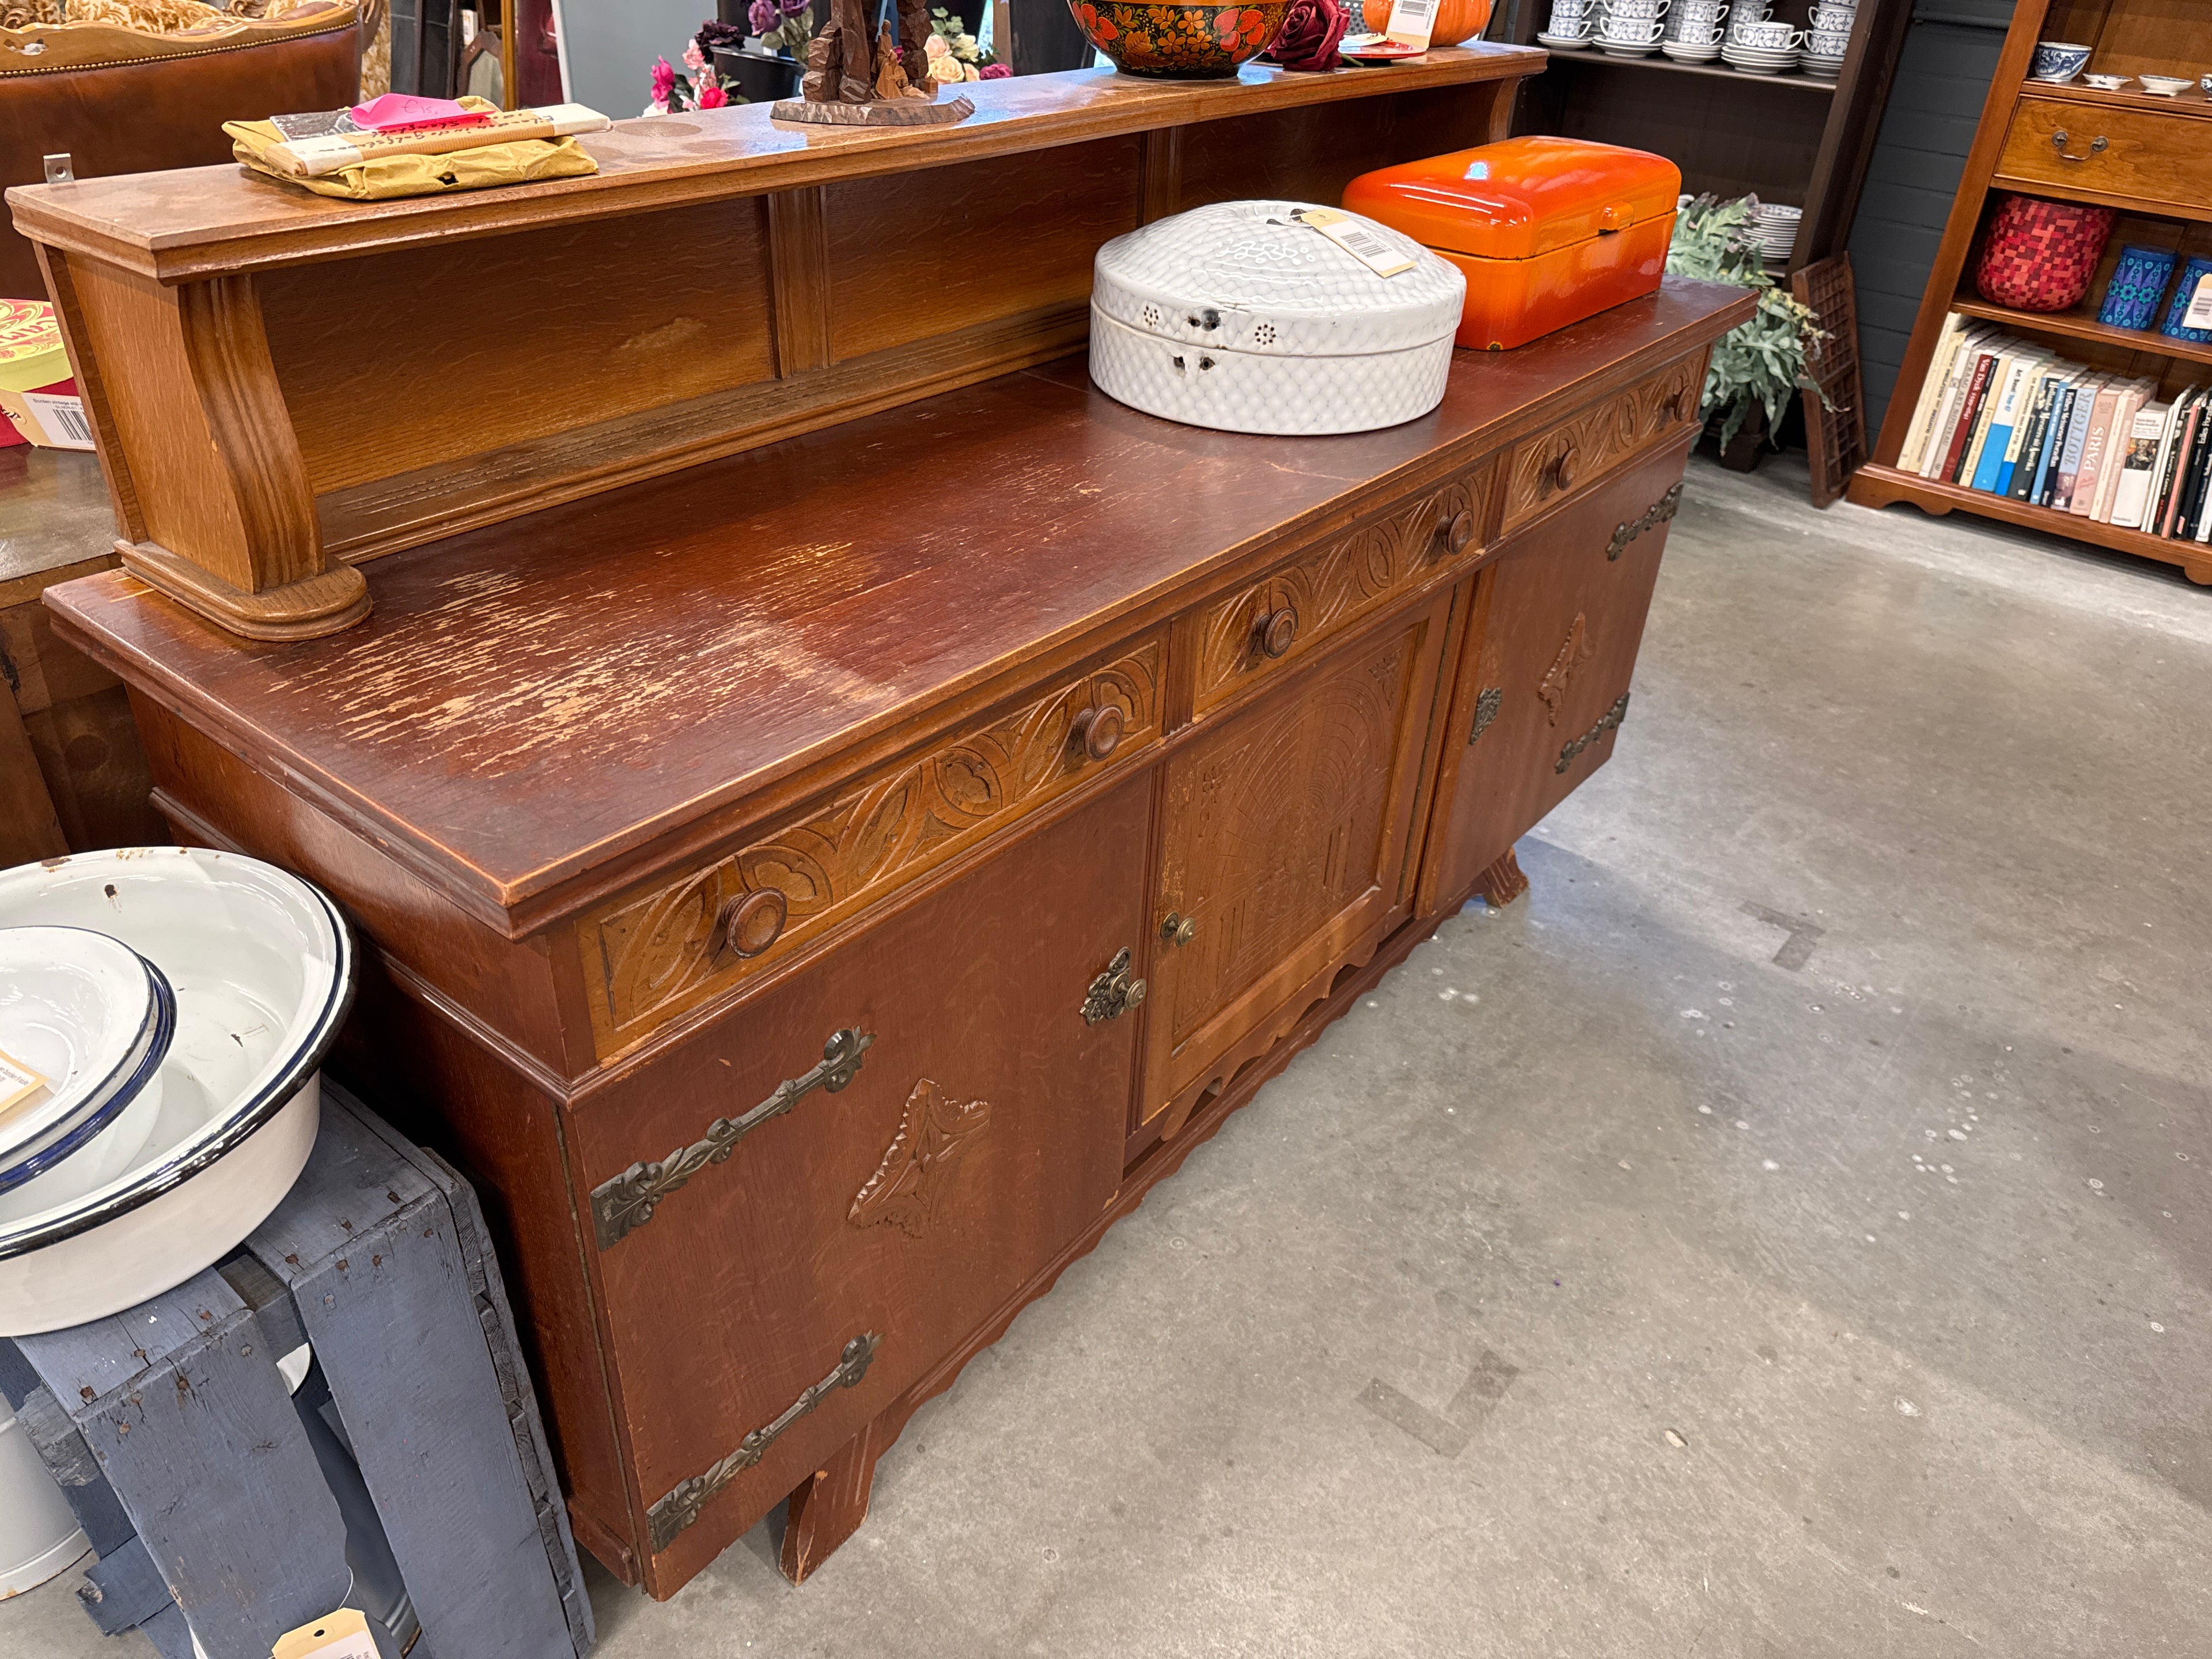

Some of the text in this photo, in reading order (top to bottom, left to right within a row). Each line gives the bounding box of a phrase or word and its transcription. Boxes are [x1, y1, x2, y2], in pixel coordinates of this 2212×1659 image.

[1979, 358, 1990, 372] Van
[1972, 373, 1986, 391] Dyck
[2044, 381, 2060, 411] Hollandse
[2036, 411, 2051, 438] Meesters
[2025, 446, 2040, 472] Amerika
[2049, 441, 2063, 467] Porzellan
[2083, 426, 2105, 471] PARIS
